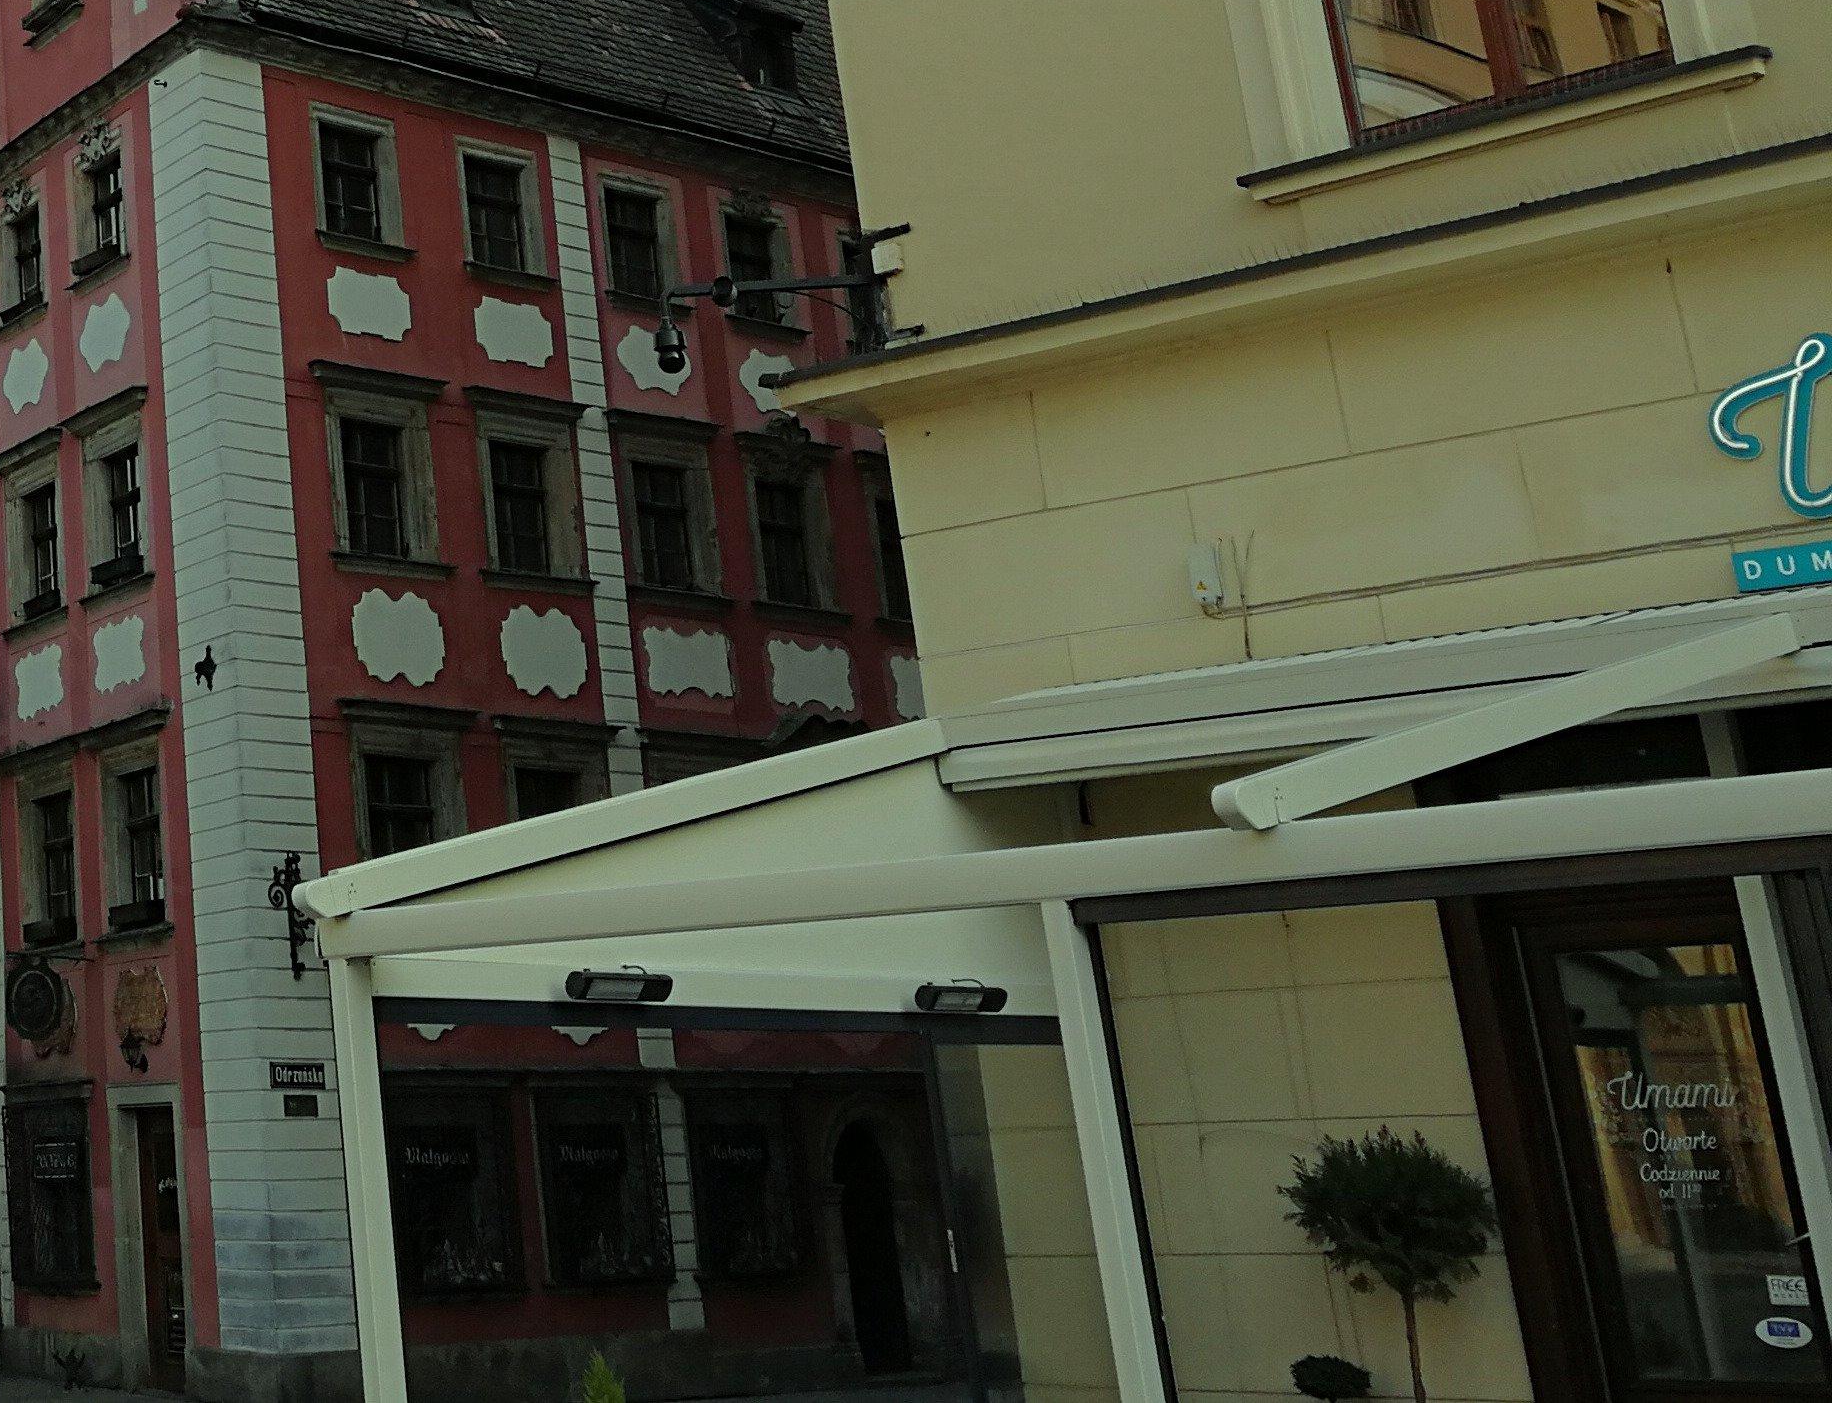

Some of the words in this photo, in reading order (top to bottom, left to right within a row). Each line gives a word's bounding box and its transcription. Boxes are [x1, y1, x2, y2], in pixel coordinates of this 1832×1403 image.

[1742, 549, 1832, 581] DUM
[1606, 1070, 1735, 1110] Umami
[1642, 1127, 1718, 1152] Otwarte
[1639, 1162, 1721, 1182] Codziennie
[1658, 1183, 1675, 1199] od
